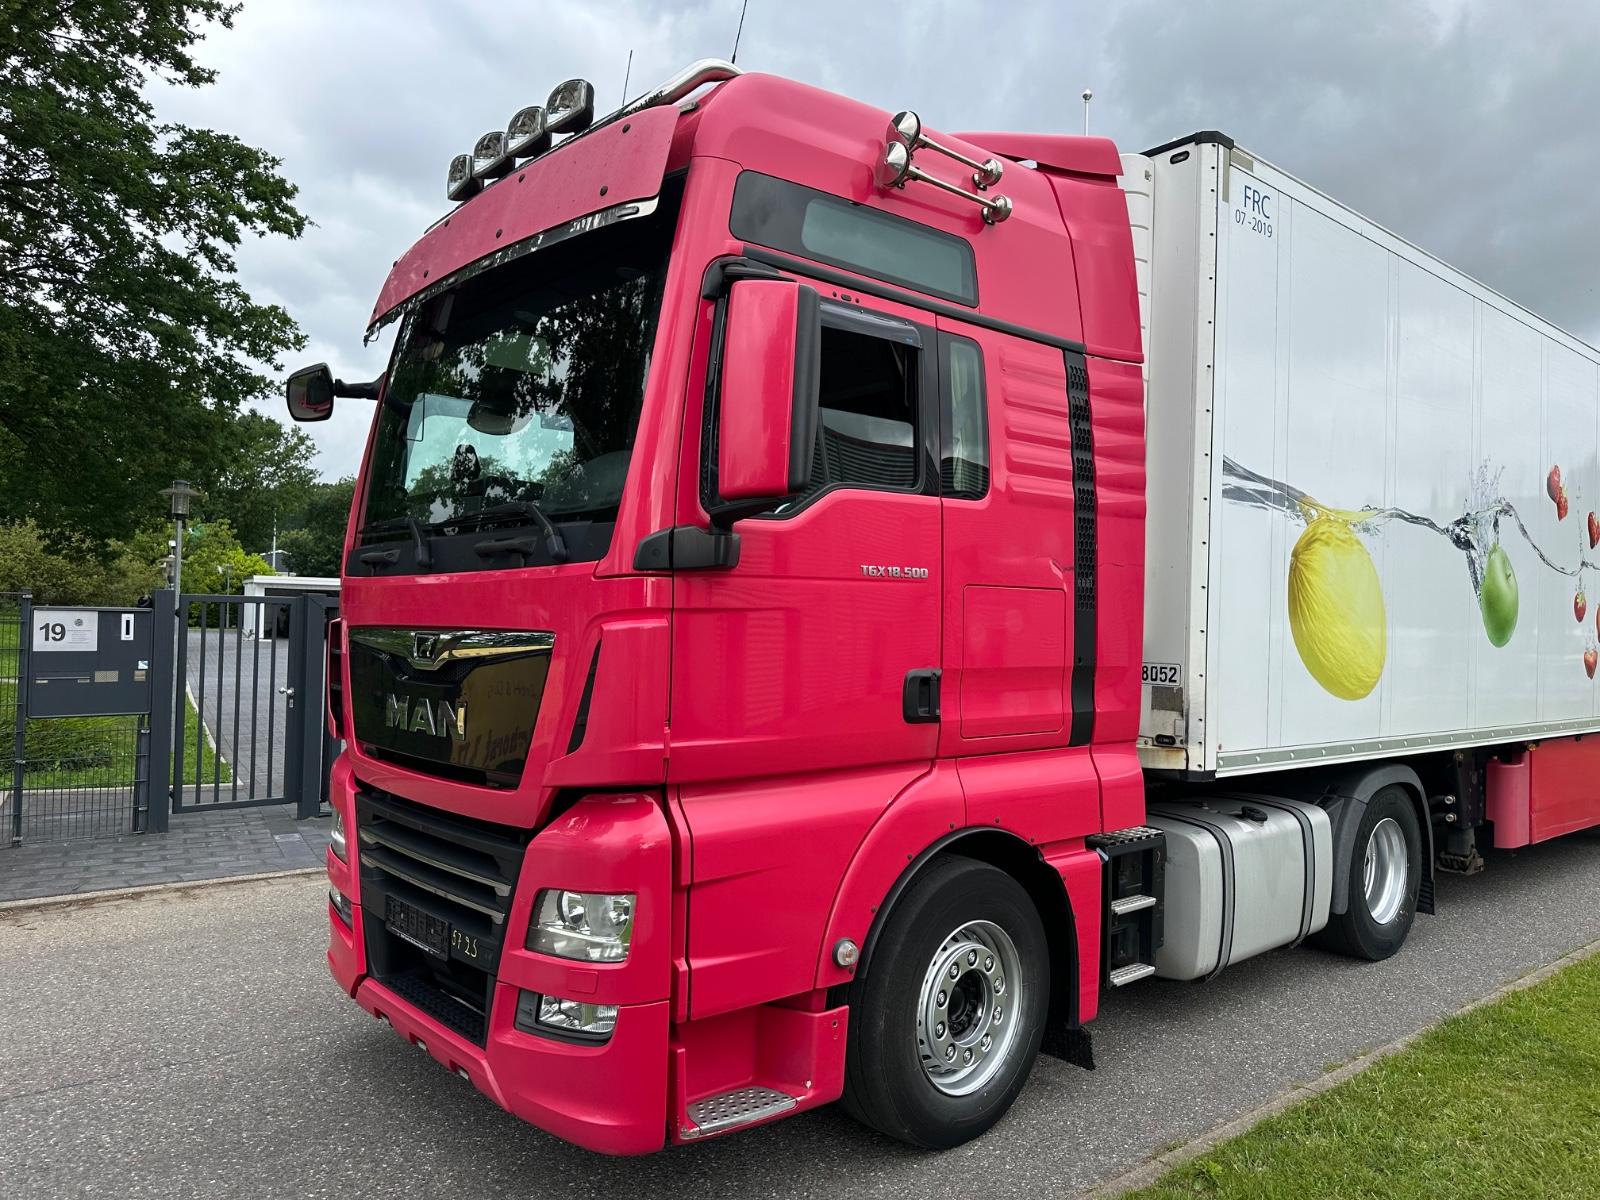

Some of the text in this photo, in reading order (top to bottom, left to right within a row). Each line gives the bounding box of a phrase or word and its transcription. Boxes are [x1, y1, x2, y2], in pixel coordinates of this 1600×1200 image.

[1244, 184, 1271, 219] FRC
[860, 564, 929, 579] TGX 18.500
[39, 622, 66, 642] 19
[1141, 665, 1178, 683] 8052
[385, 693, 467, 741] MAN
